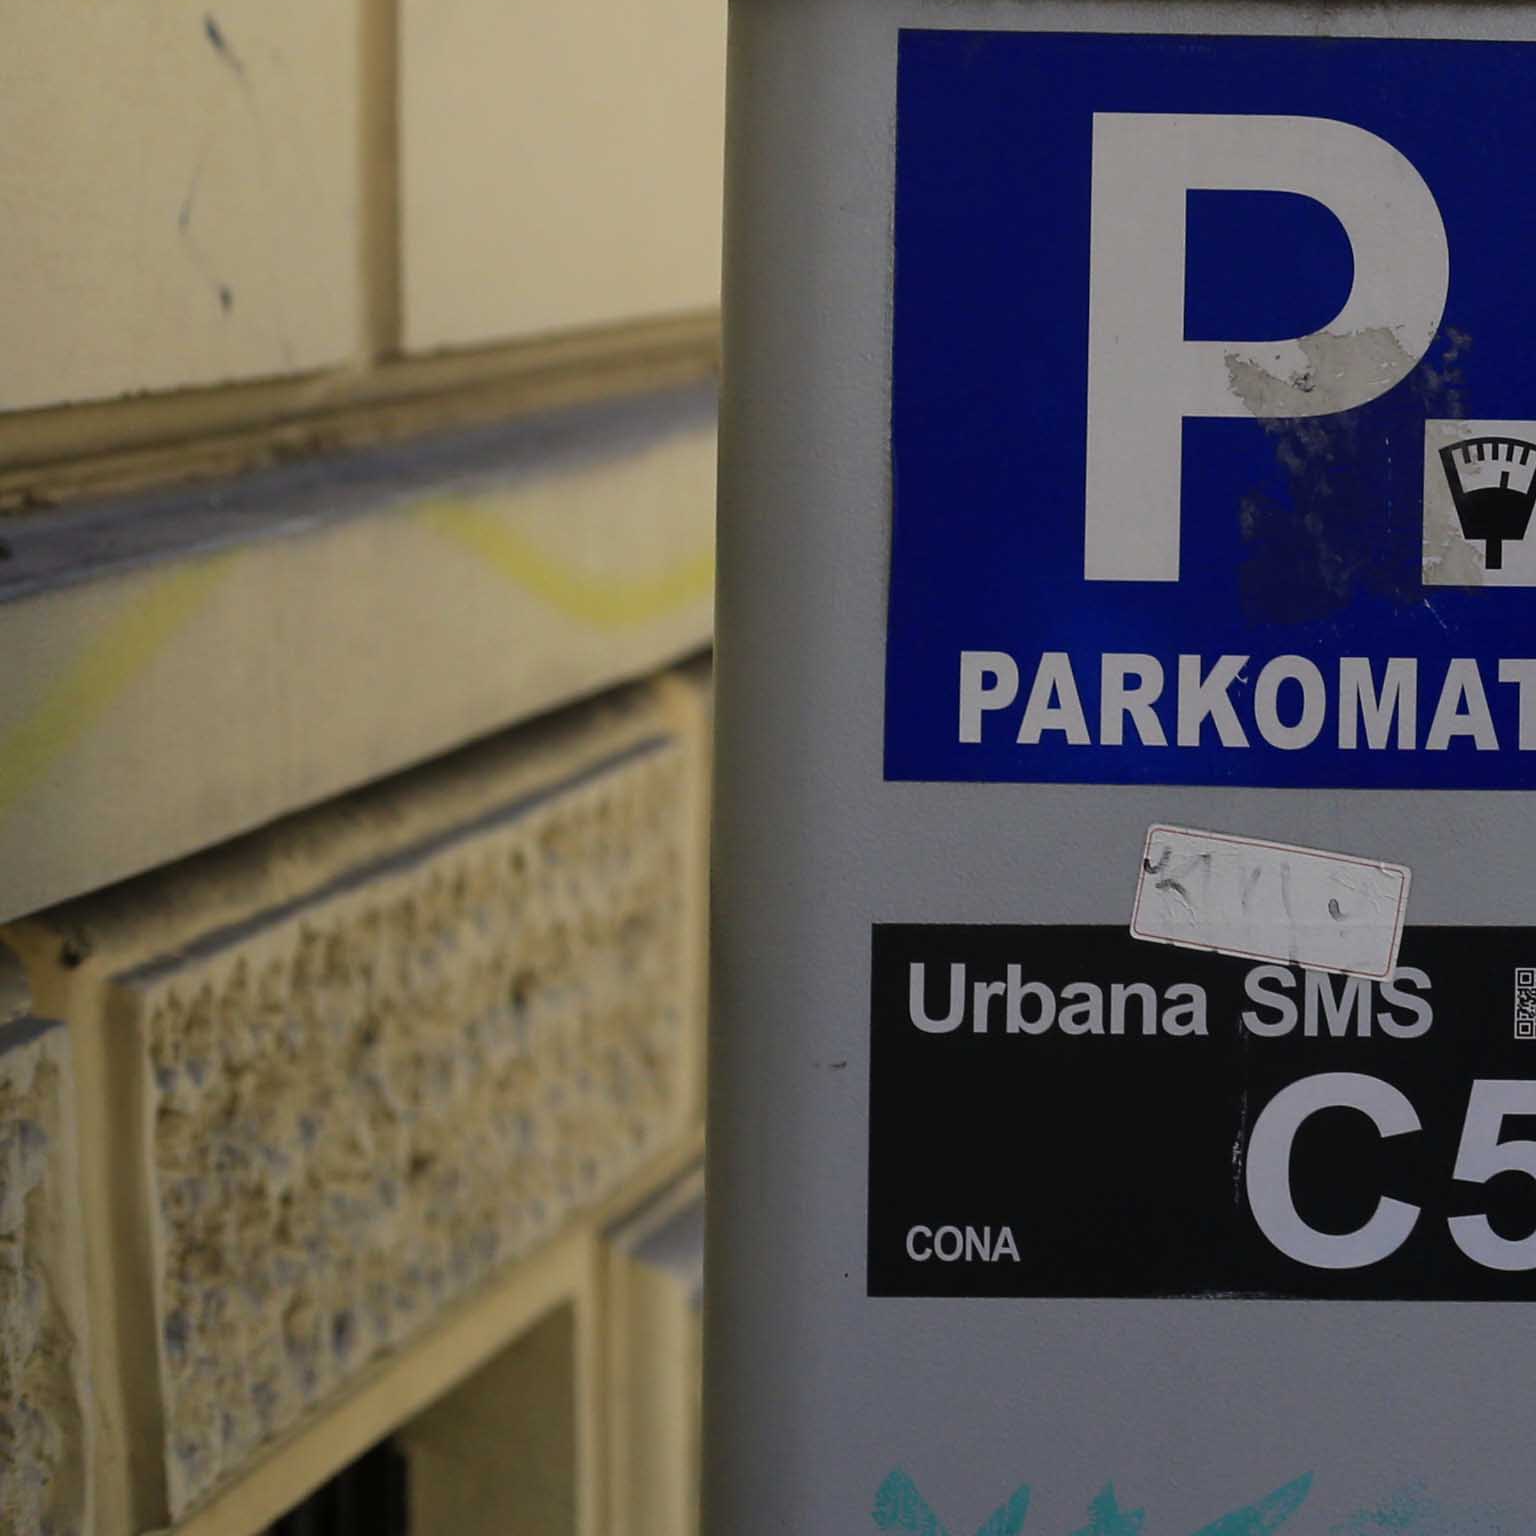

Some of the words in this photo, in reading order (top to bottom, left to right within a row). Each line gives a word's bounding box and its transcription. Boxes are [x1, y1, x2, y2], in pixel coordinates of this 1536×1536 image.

[1083, 111, 1450, 582] P
[909, 962, 1209, 1037] Urbana
[1241, 964, 1434, 1039] SMS
[905, 1224, 1021, 1263] CONA
